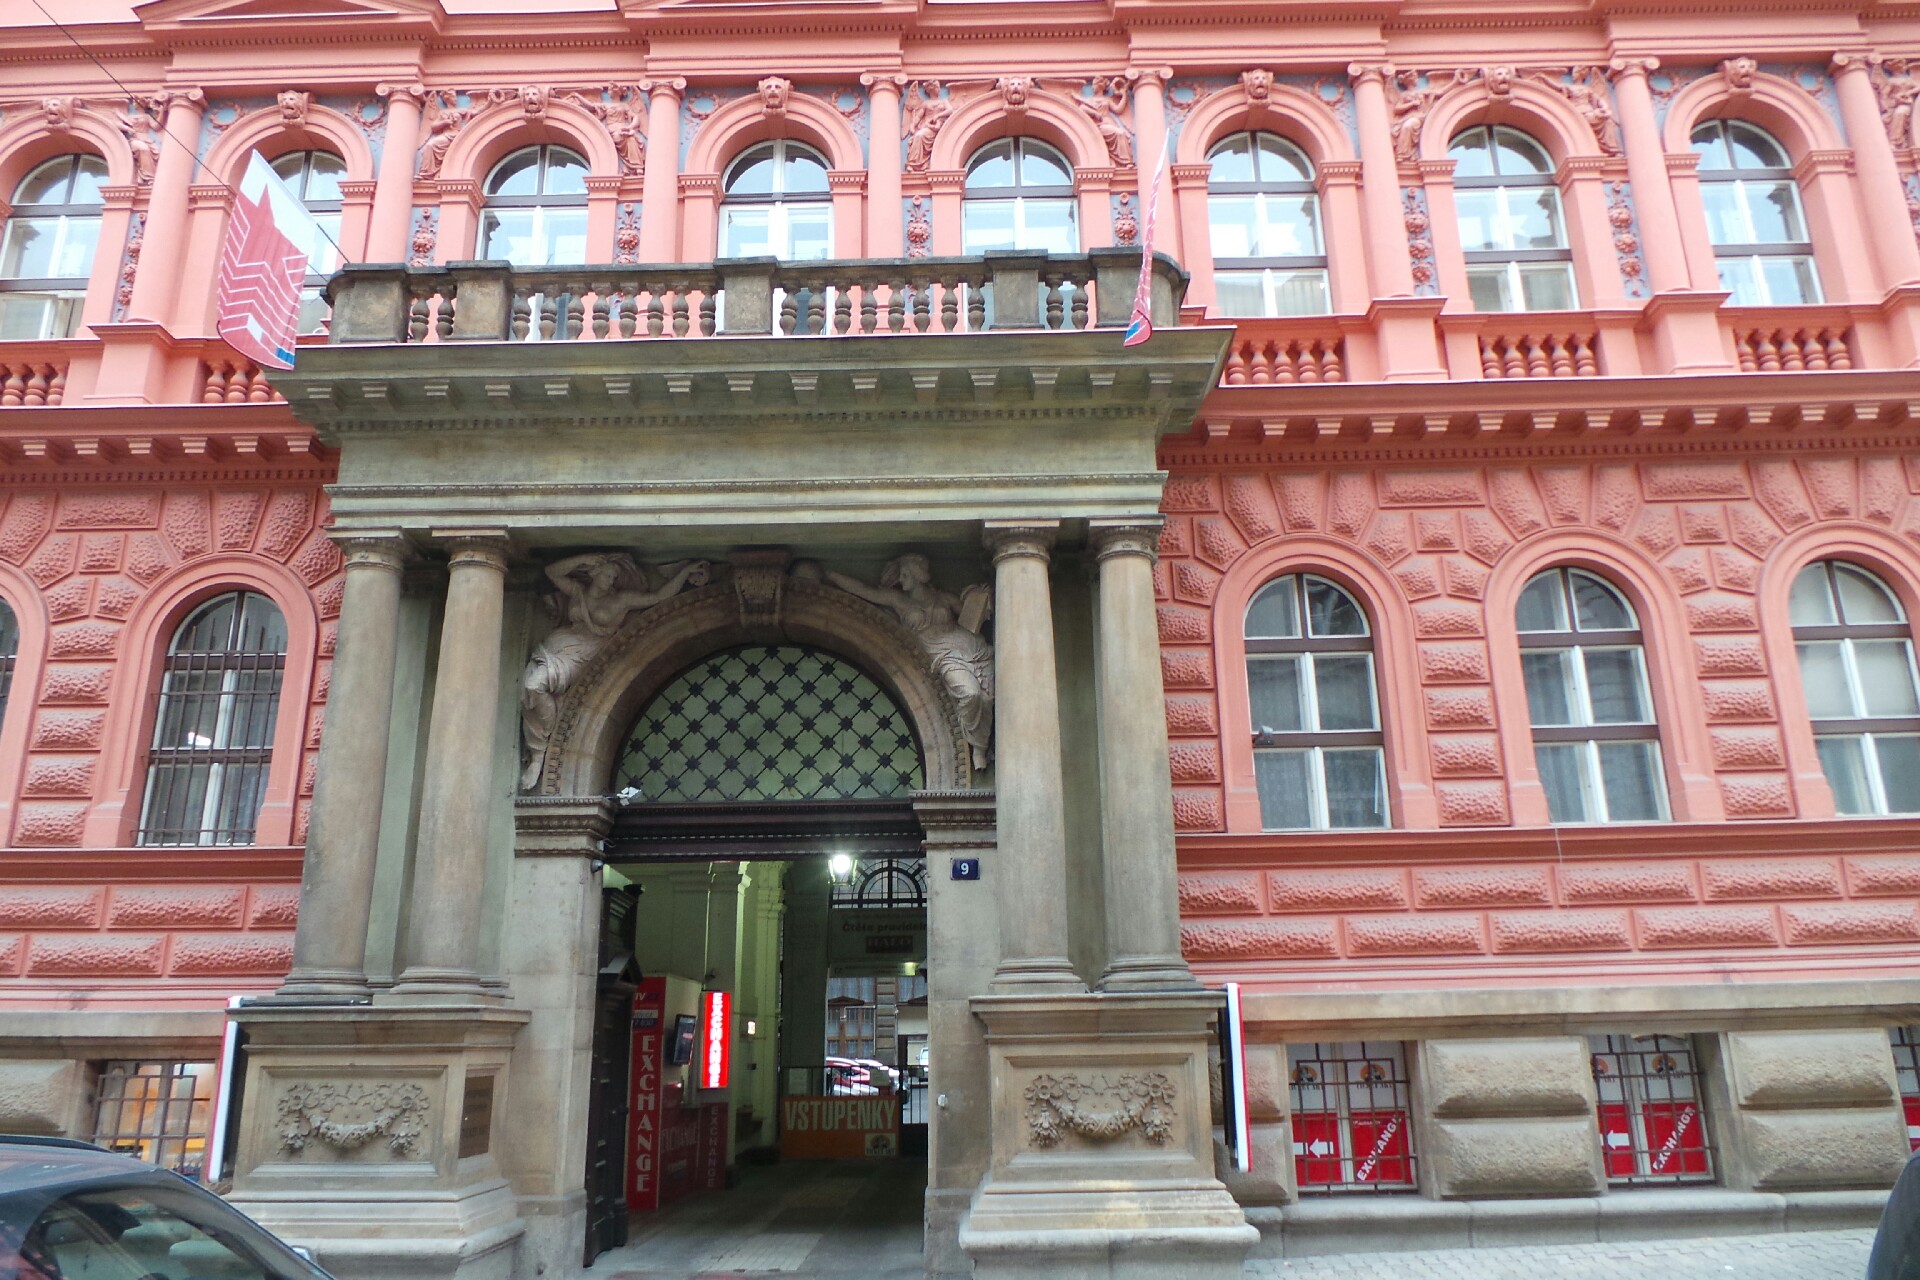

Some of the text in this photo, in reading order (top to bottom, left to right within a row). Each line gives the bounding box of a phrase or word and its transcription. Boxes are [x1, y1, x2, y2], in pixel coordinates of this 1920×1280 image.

[961, 863, 969, 875] 9
[708, 992, 723, 1088] EXCHANGE
[636, 1035, 656, 1192] EXCHANGE
[707, 1105, 719, 1188] EXCHANGE
[784, 1100, 896, 1131] VSTUPENKY
